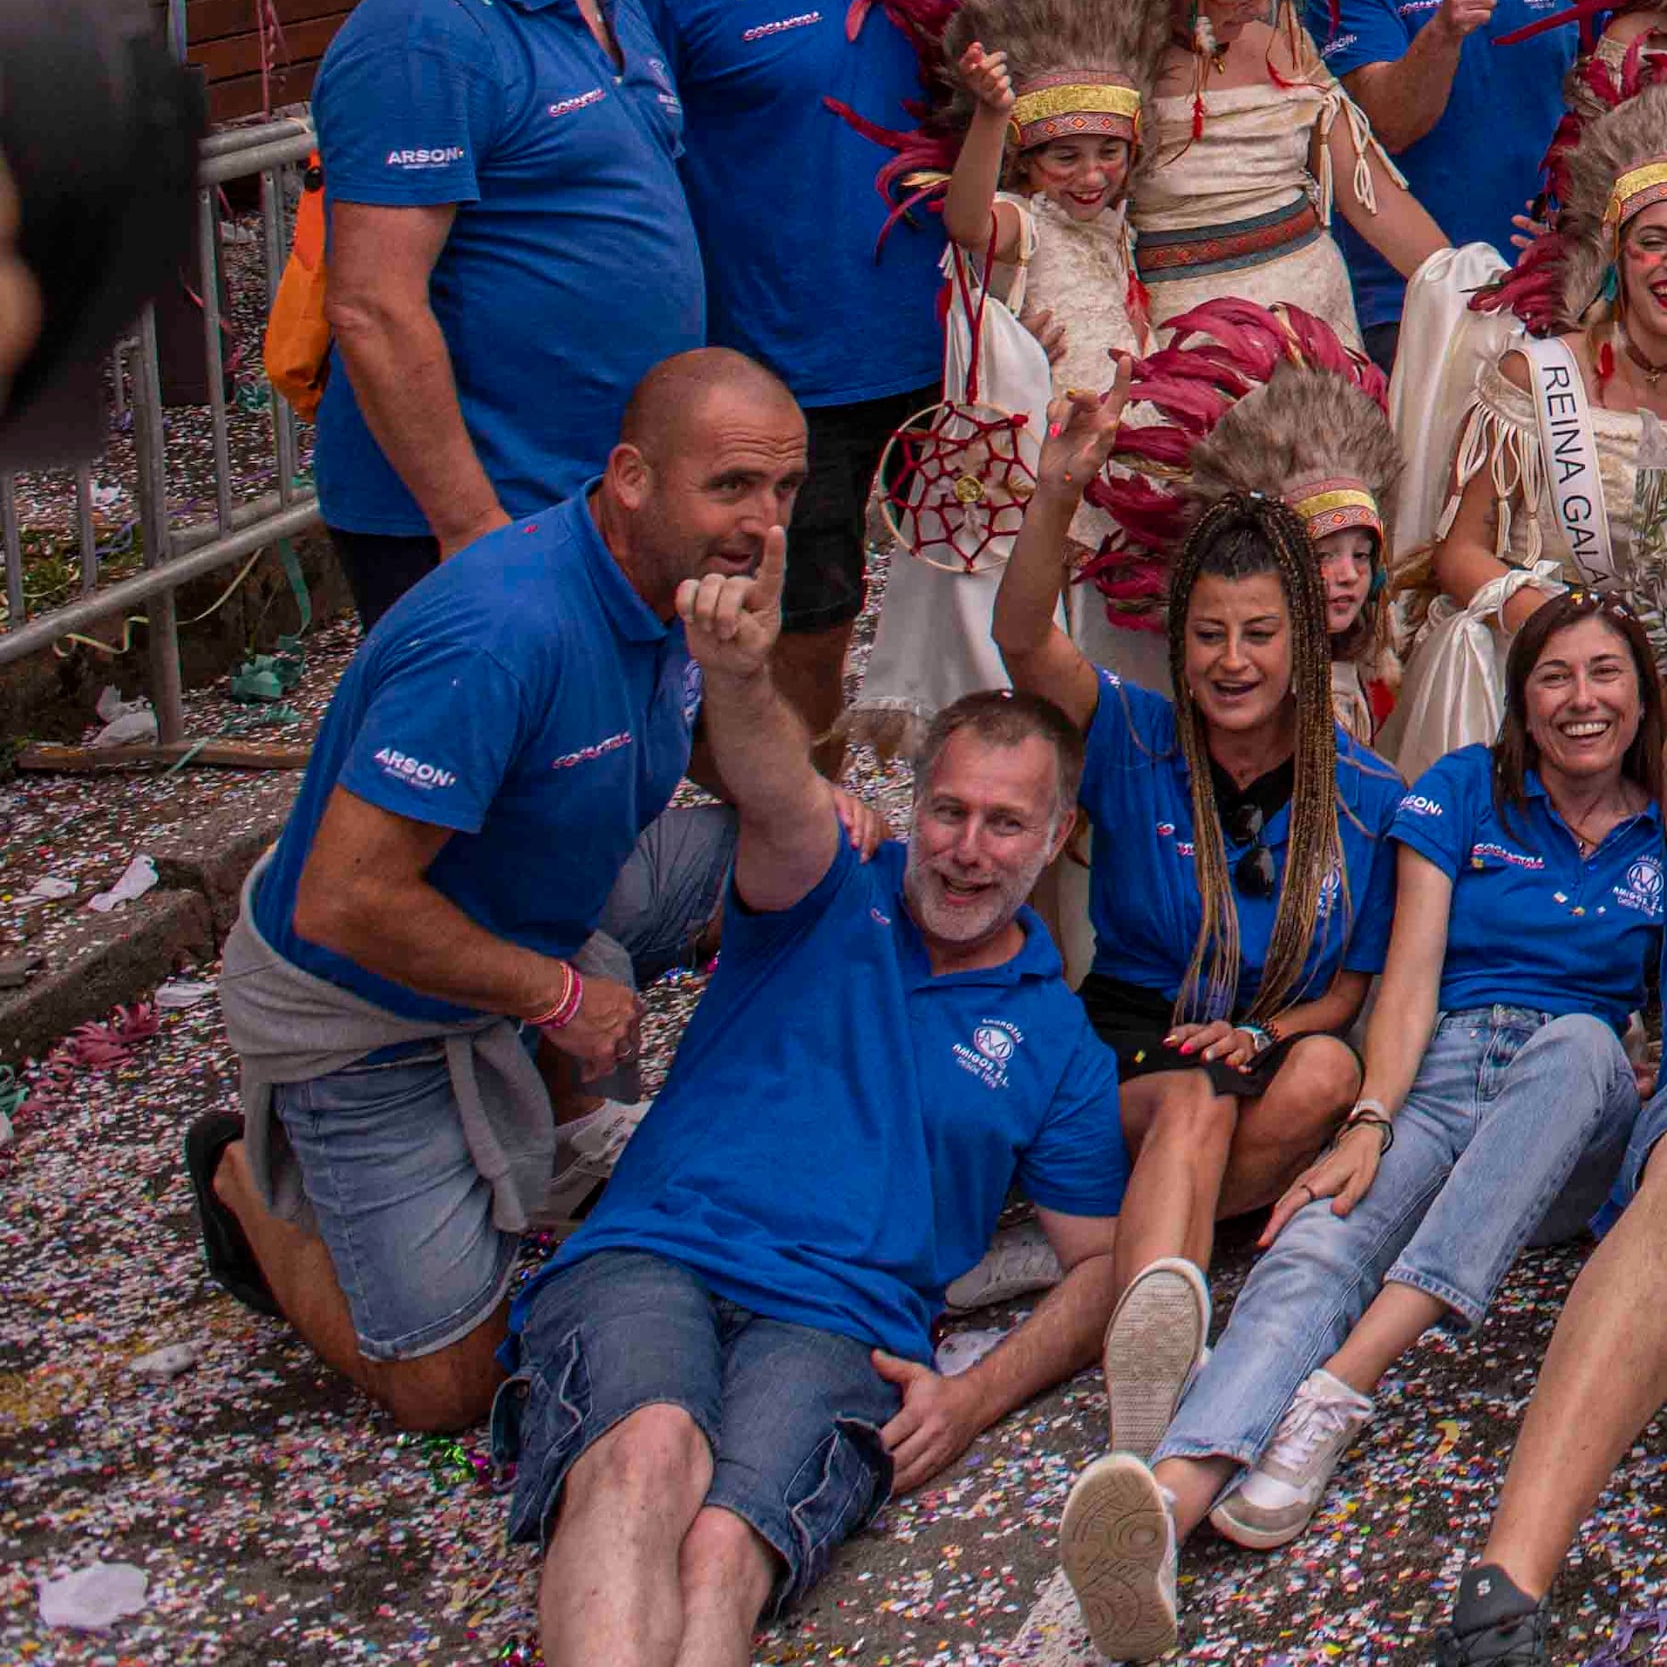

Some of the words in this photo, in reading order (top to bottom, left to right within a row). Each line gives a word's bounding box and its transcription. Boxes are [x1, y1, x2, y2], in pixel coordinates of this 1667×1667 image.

[386, 148, 458, 165] ARSON
[1542, 365, 1587, 485] REINA
[1562, 494, 1610, 586] GALA
[374, 746, 452, 787] ARSON
